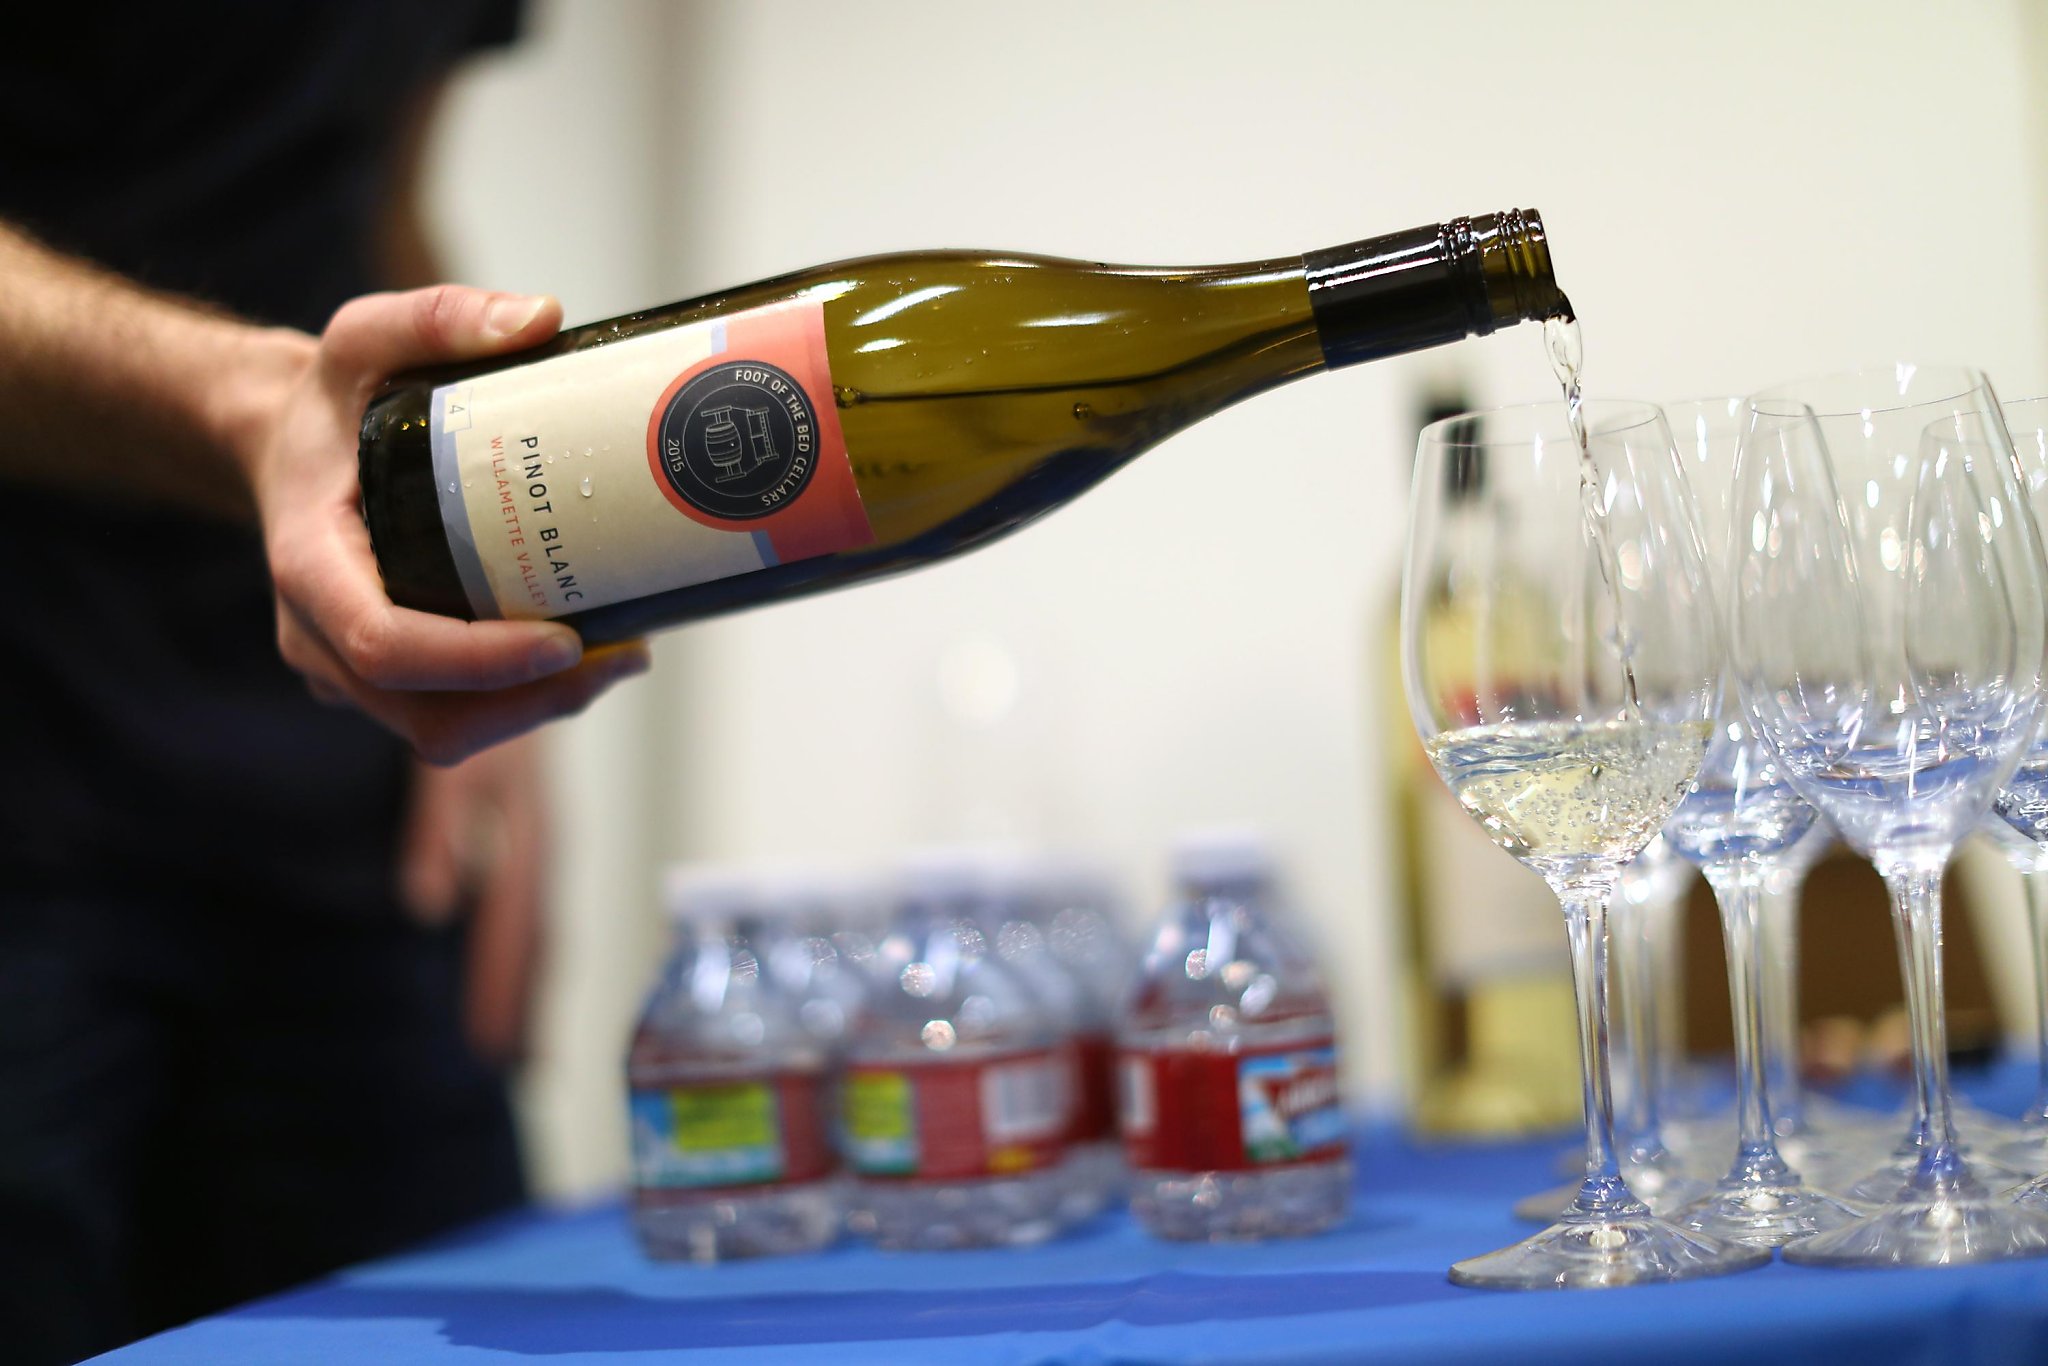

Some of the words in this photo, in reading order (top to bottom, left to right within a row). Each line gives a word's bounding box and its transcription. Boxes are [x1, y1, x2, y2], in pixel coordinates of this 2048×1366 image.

[735, 369, 770, 385] FOOT
[771, 379, 789, 395] OF
[449, 404, 465, 414] 4
[786, 395, 806, 422] THE
[797, 424, 810, 452] BED
[668, 438, 685, 473] 2015
[761, 457, 808, 507] CELLARS
[491, 436, 525, 547] WILLAMETTE
[516, 552, 548, 608] VALLEY
[520, 436, 553, 514] PINOT
[539, 527, 583, 602] BLANC
